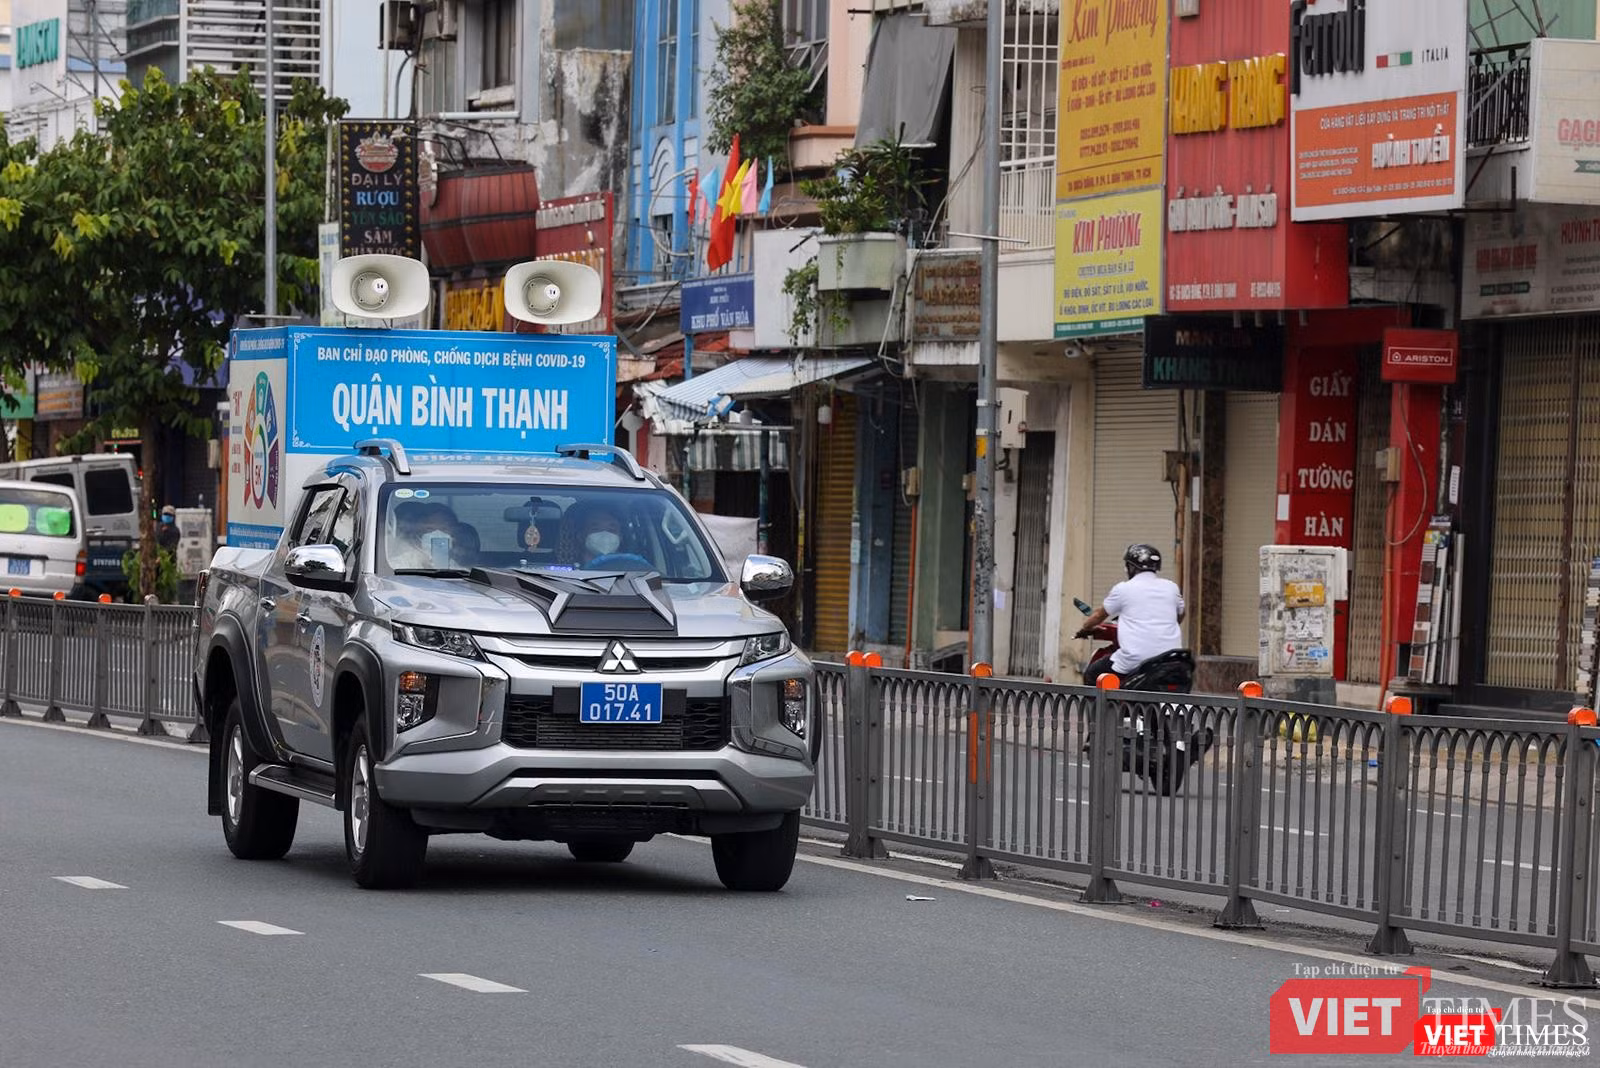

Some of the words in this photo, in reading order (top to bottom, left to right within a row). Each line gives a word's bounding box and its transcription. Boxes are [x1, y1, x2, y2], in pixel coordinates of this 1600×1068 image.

[1421, 49, 1449, 63] ITALIA
[356, 189, 400, 208] RƯỢU
[1073, 219, 1095, 254] KIM
[317, 346, 340, 361] BAN
[343, 343, 363, 362] CHỈ
[365, 348, 388, 365] ĐẠO
[391, 346, 431, 366] PHÒNG,
[433, 345, 471, 365] CHỐNG
[474, 351, 499, 369] DỊCH
[502, 349, 533, 369] BỆNH
[535, 354, 586, 368] COVID-19
[1404, 354, 1449, 363] ARISTON
[1309, 370, 1352, 397] GIẤY
[332, 372, 402, 435] QUẬN
[411, 373, 473, 428] BÌNH
[481, 386, 569, 440] THẠNH
[1309, 417, 1347, 442] DÁN
[1298, 462, 1354, 489] TƯỜNG
[1304, 511, 1344, 537] HÀN
[604, 684, 639, 701] 50A
[590, 703, 651, 720] 017.41
